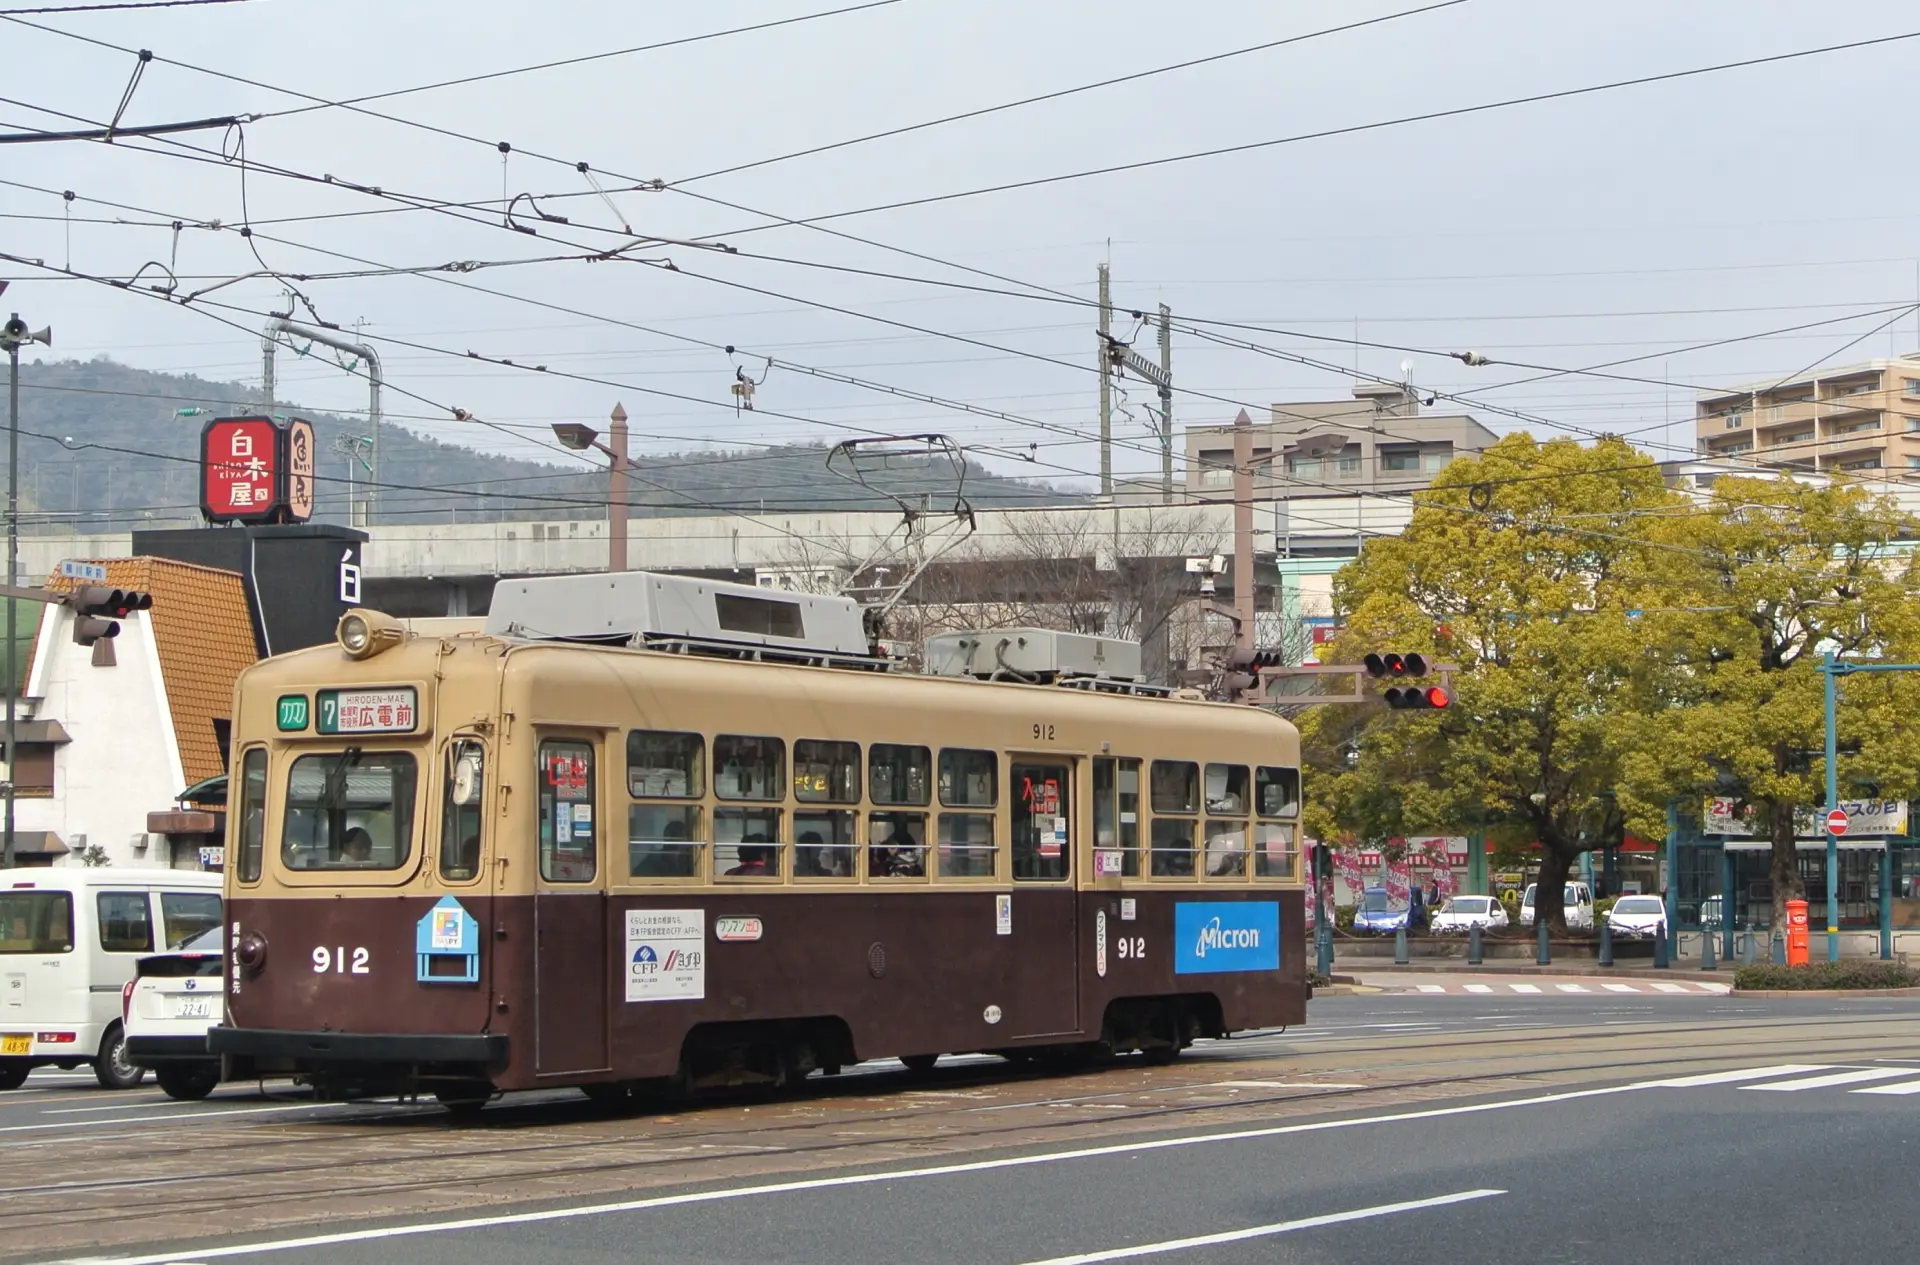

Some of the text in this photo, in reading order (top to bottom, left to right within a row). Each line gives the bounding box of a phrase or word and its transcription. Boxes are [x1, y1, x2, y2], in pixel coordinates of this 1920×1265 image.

[229, 428, 269, 506] 白木屋
[340, 547, 361, 604] 白
[324, 699, 336, 726] 7
[346, 694, 405, 705] HIRODEN-MAE
[359, 704, 413, 727] 広電前
[1033, 723, 1056, 741] 912
[1022, 776, 1058, 802] 入口
[1097, 915, 1105, 971] ワンマン入口
[1118, 937, 1146, 959] 912
[1195, 916, 1260, 958] Micron
[312, 946, 370, 975] 912
[632, 963, 659, 975] CFP
